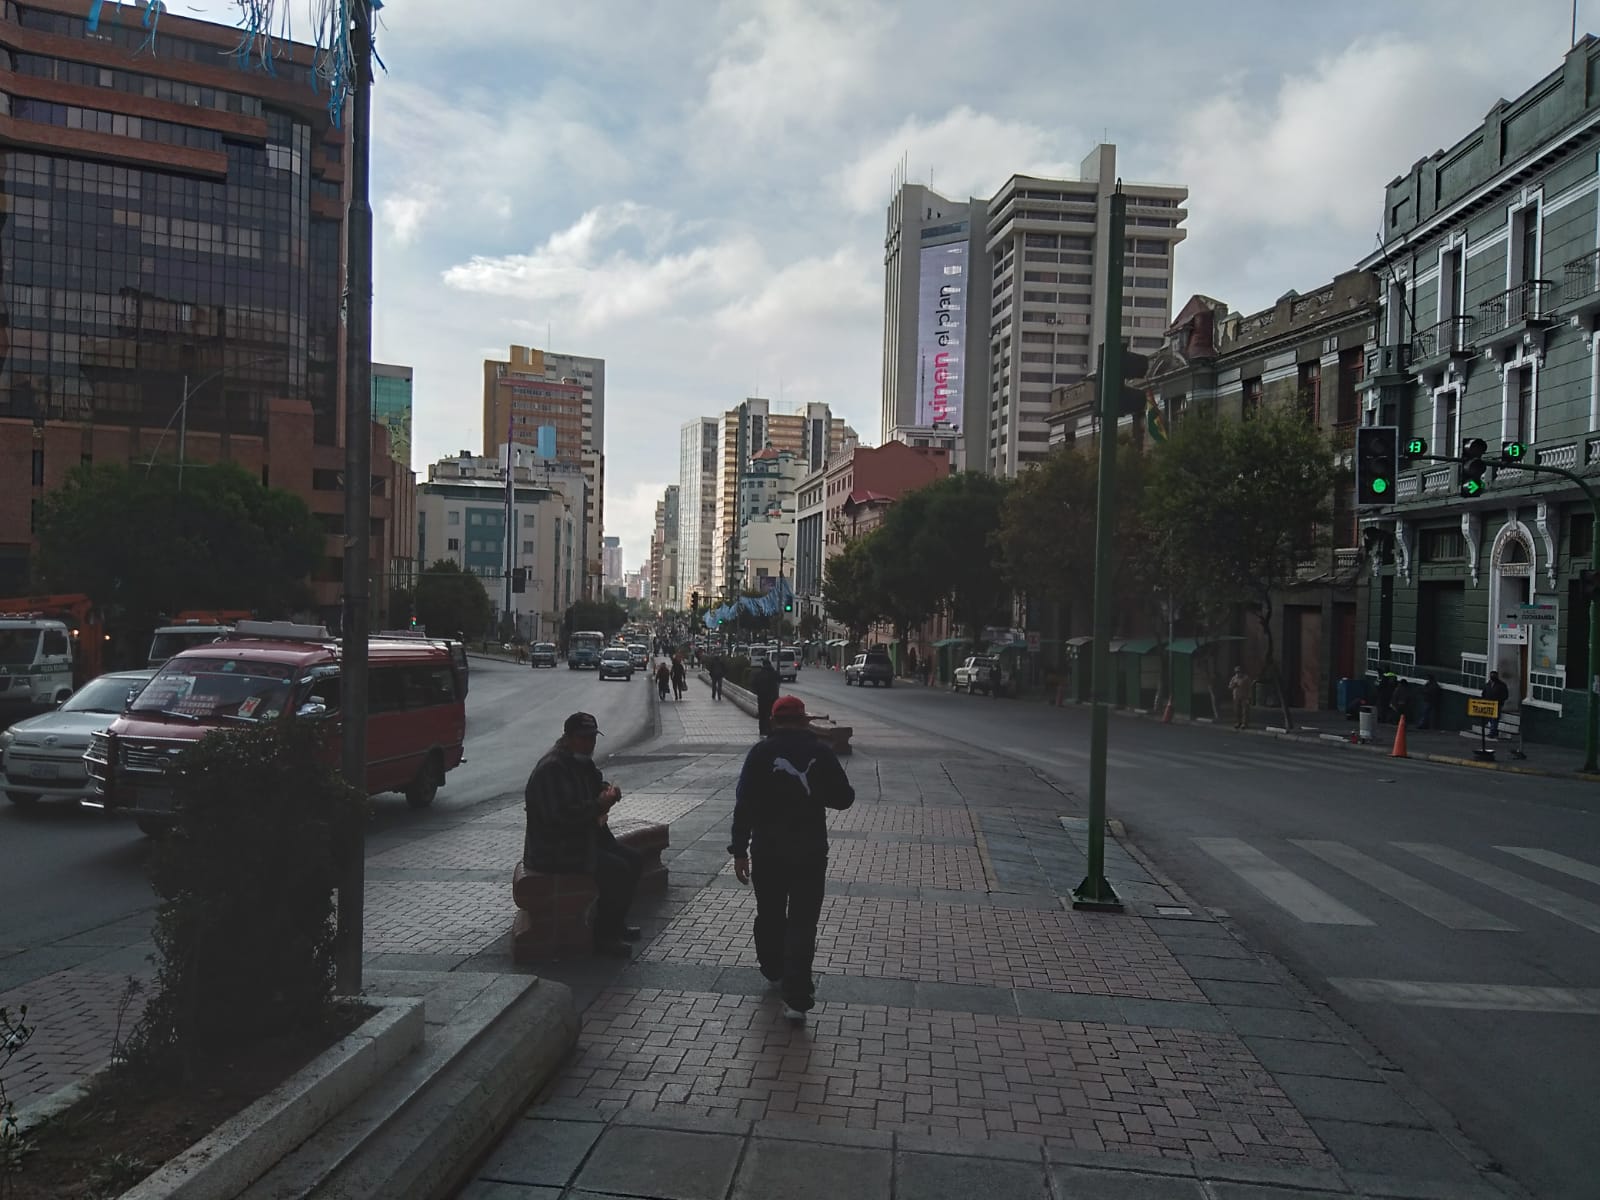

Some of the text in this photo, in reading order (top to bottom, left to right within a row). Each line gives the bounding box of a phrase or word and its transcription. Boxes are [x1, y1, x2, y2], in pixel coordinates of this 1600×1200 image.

[935, 330, 949, 347] el
[1409, 441, 1422, 453] 13
[1508, 445, 1520, 457] 13
